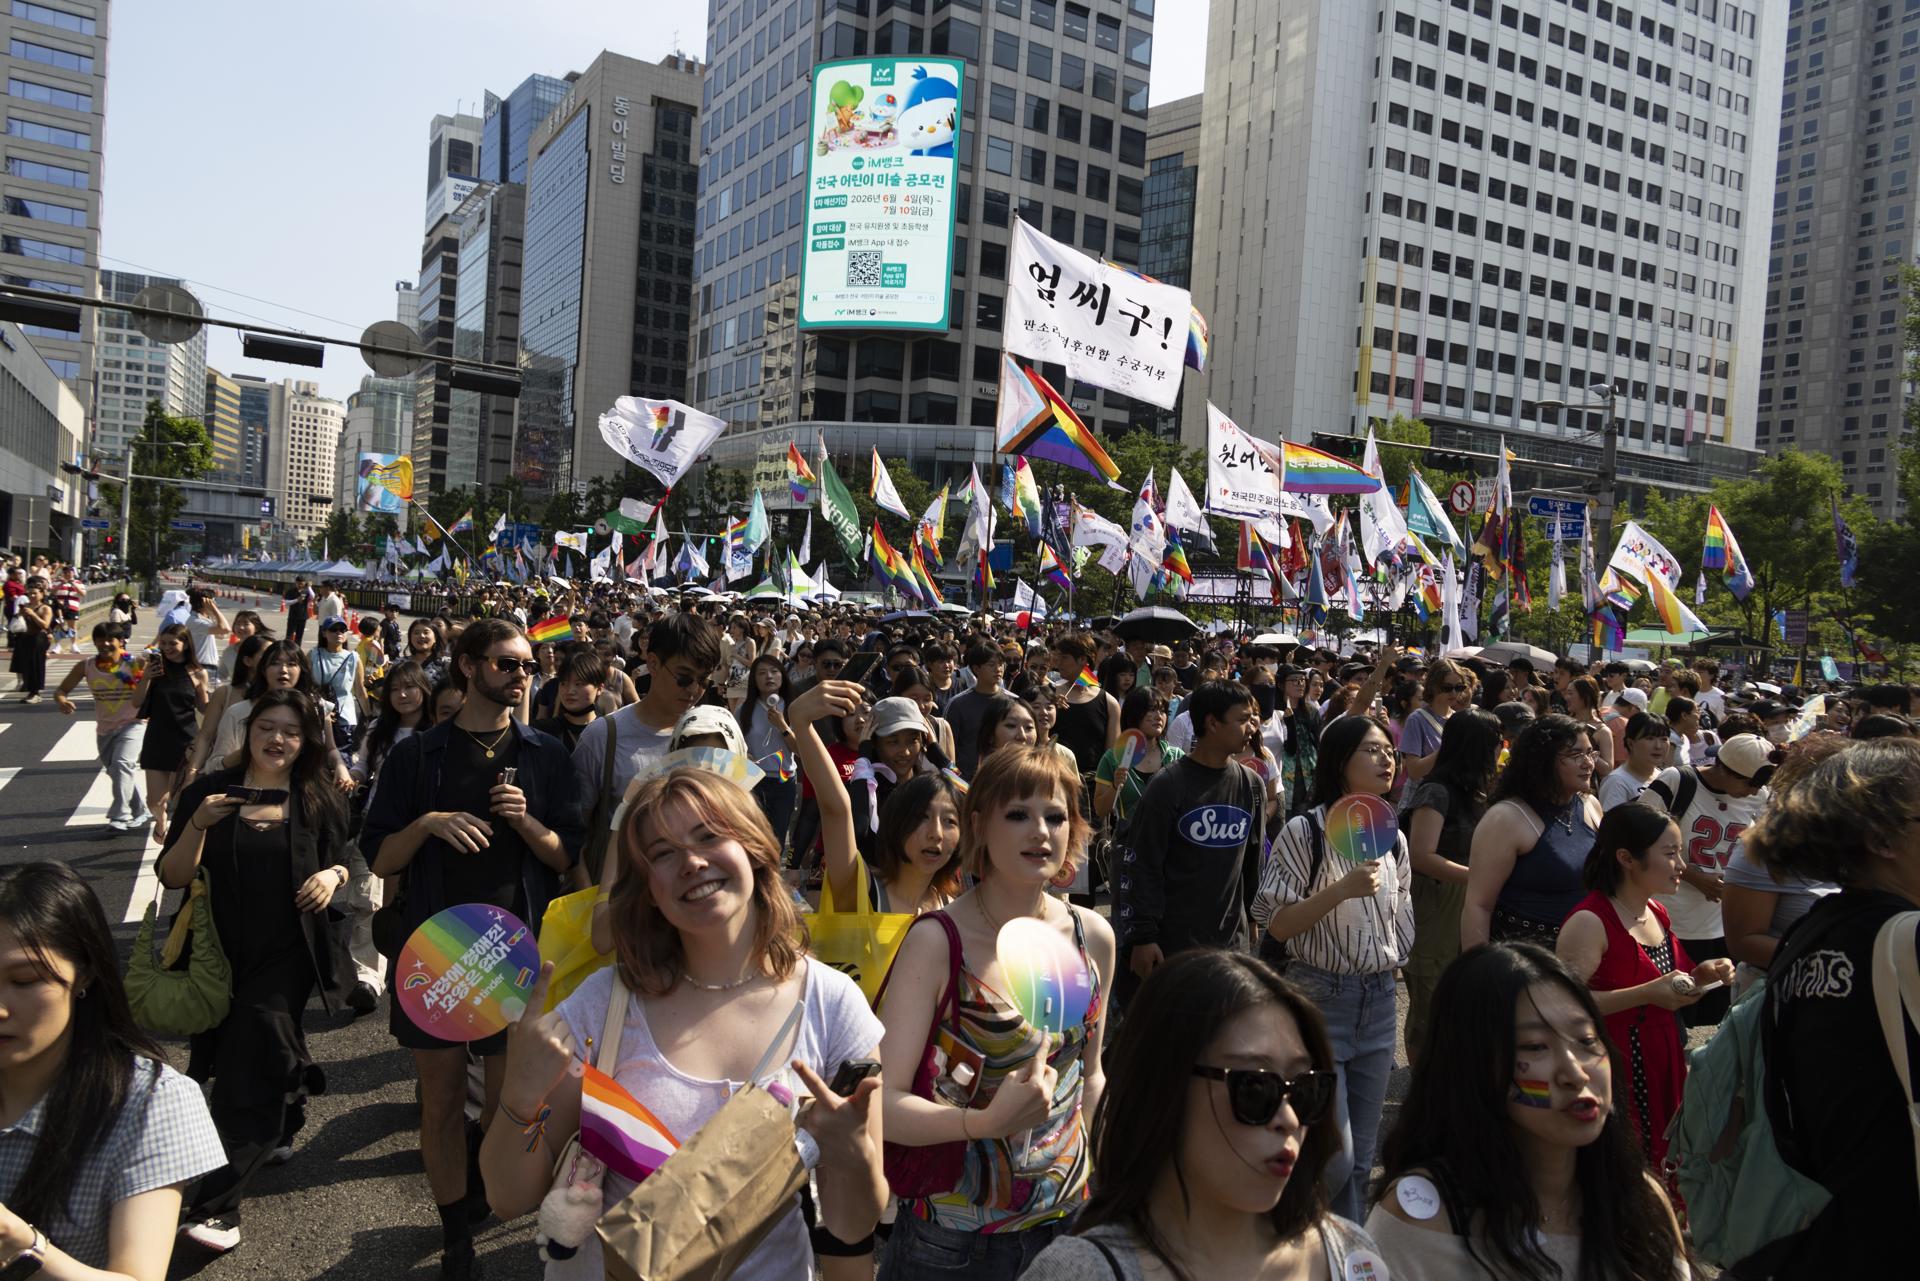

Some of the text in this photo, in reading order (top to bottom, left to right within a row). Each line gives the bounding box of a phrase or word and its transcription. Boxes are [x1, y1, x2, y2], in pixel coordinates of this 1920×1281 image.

[611, 95, 630, 185] 동아빌딩
[868, 156, 905, 169] iM뱅크
[815, 172, 946, 190] 전국 어린이 미술 공모전
[850, 194, 881, 204] 2026년
[882, 193, 898, 204] 6월
[882, 205, 934, 217] 7월 10일(금)
[871, 240, 886, 249] App
[1116, 355, 1166, 381] 수궁지부
[1190, 808, 1247, 841] Suct
[421, 922, 507, 1010] 사랑에 정해진
[438, 940, 512, 1014] 모양은 없어
[479, 972, 505, 999] tinder
